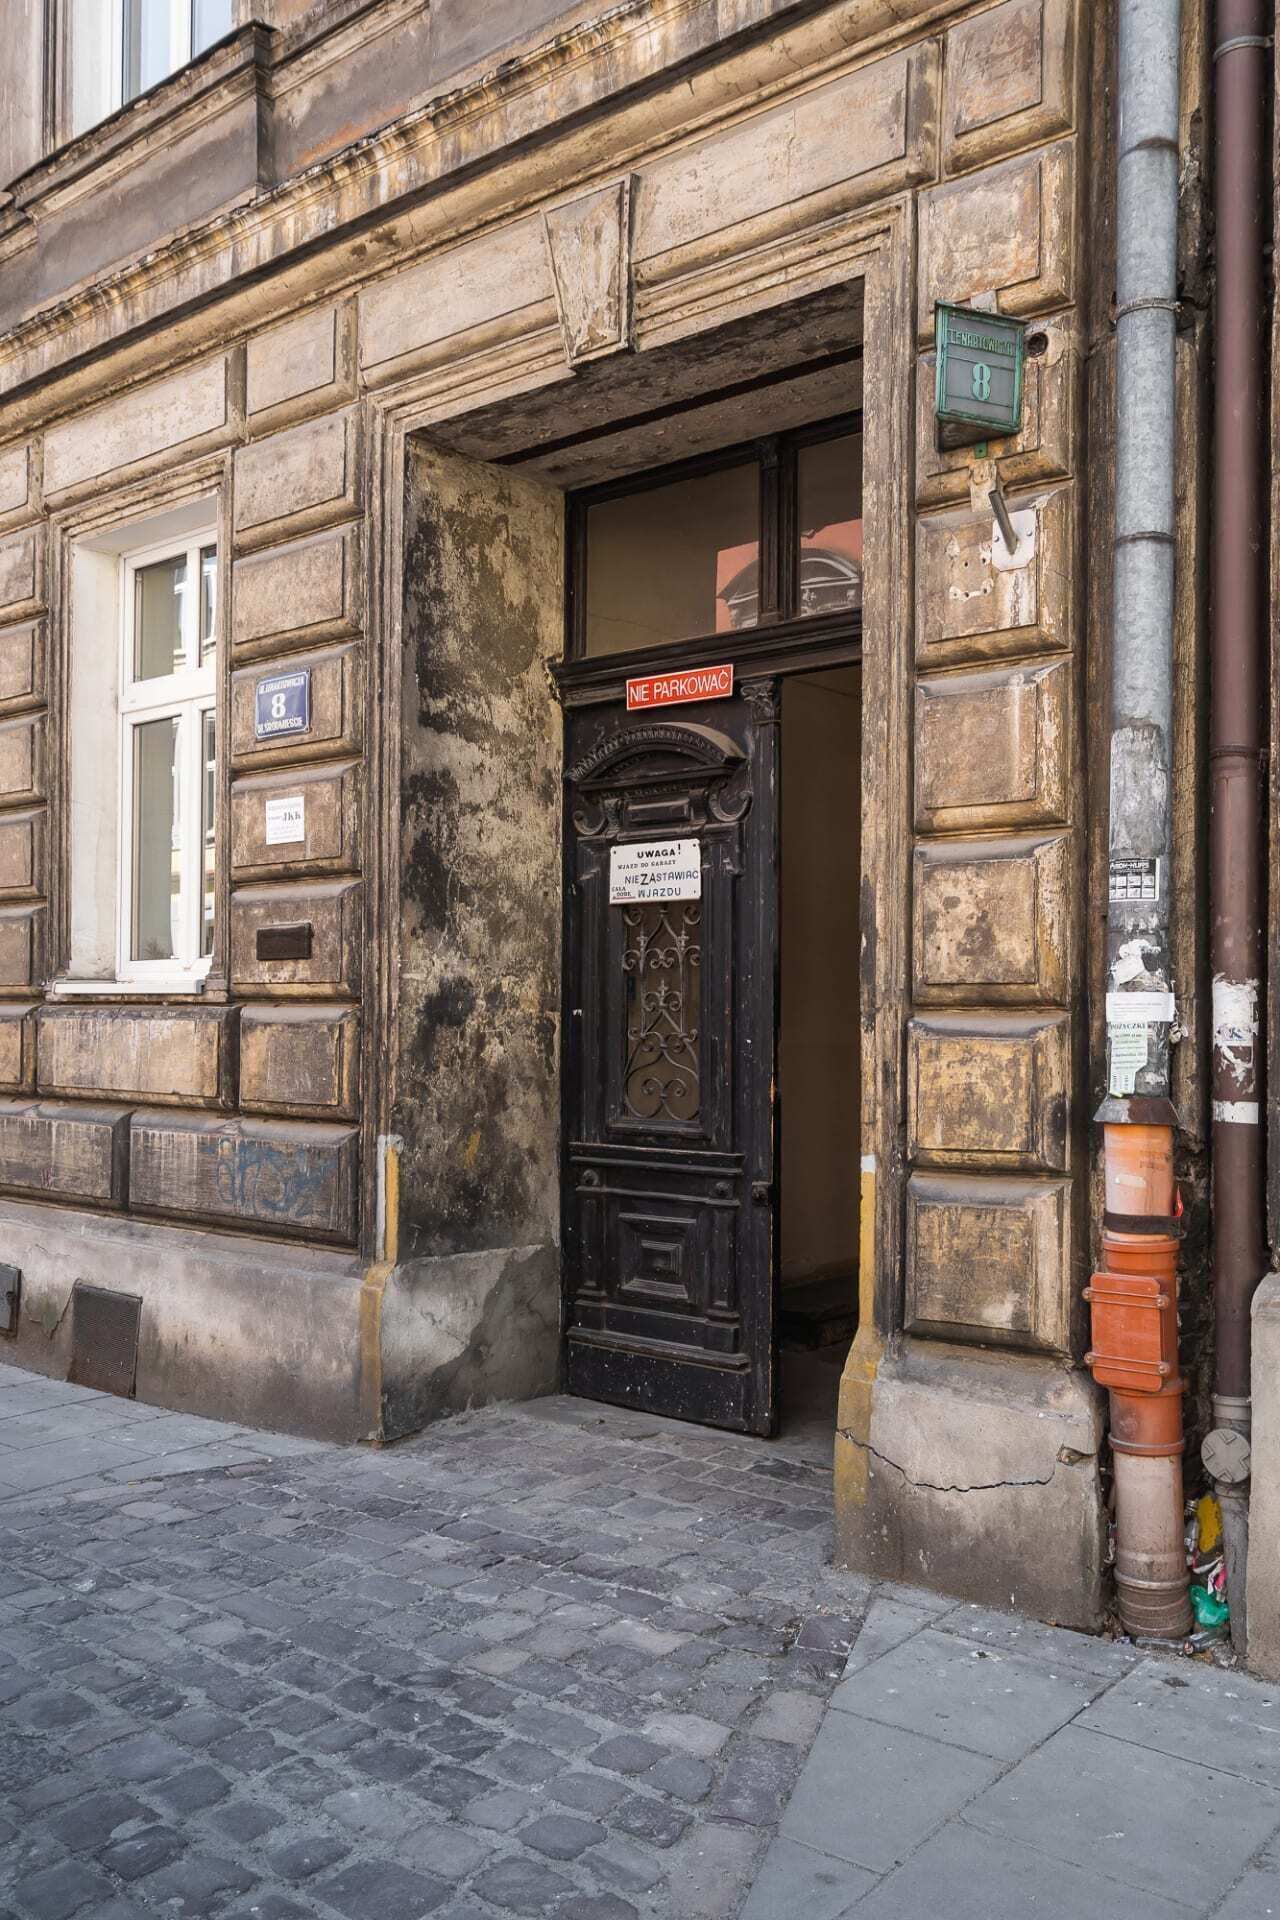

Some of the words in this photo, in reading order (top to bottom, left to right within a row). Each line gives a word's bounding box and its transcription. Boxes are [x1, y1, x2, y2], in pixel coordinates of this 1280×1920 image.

[972, 363, 991, 401] 8
[630, 684, 649, 702] NIE
[653, 669, 729, 700] PARKOWAĆ
[271, 693, 286, 719] 8
[638, 887, 681, 898] WJAZDU
